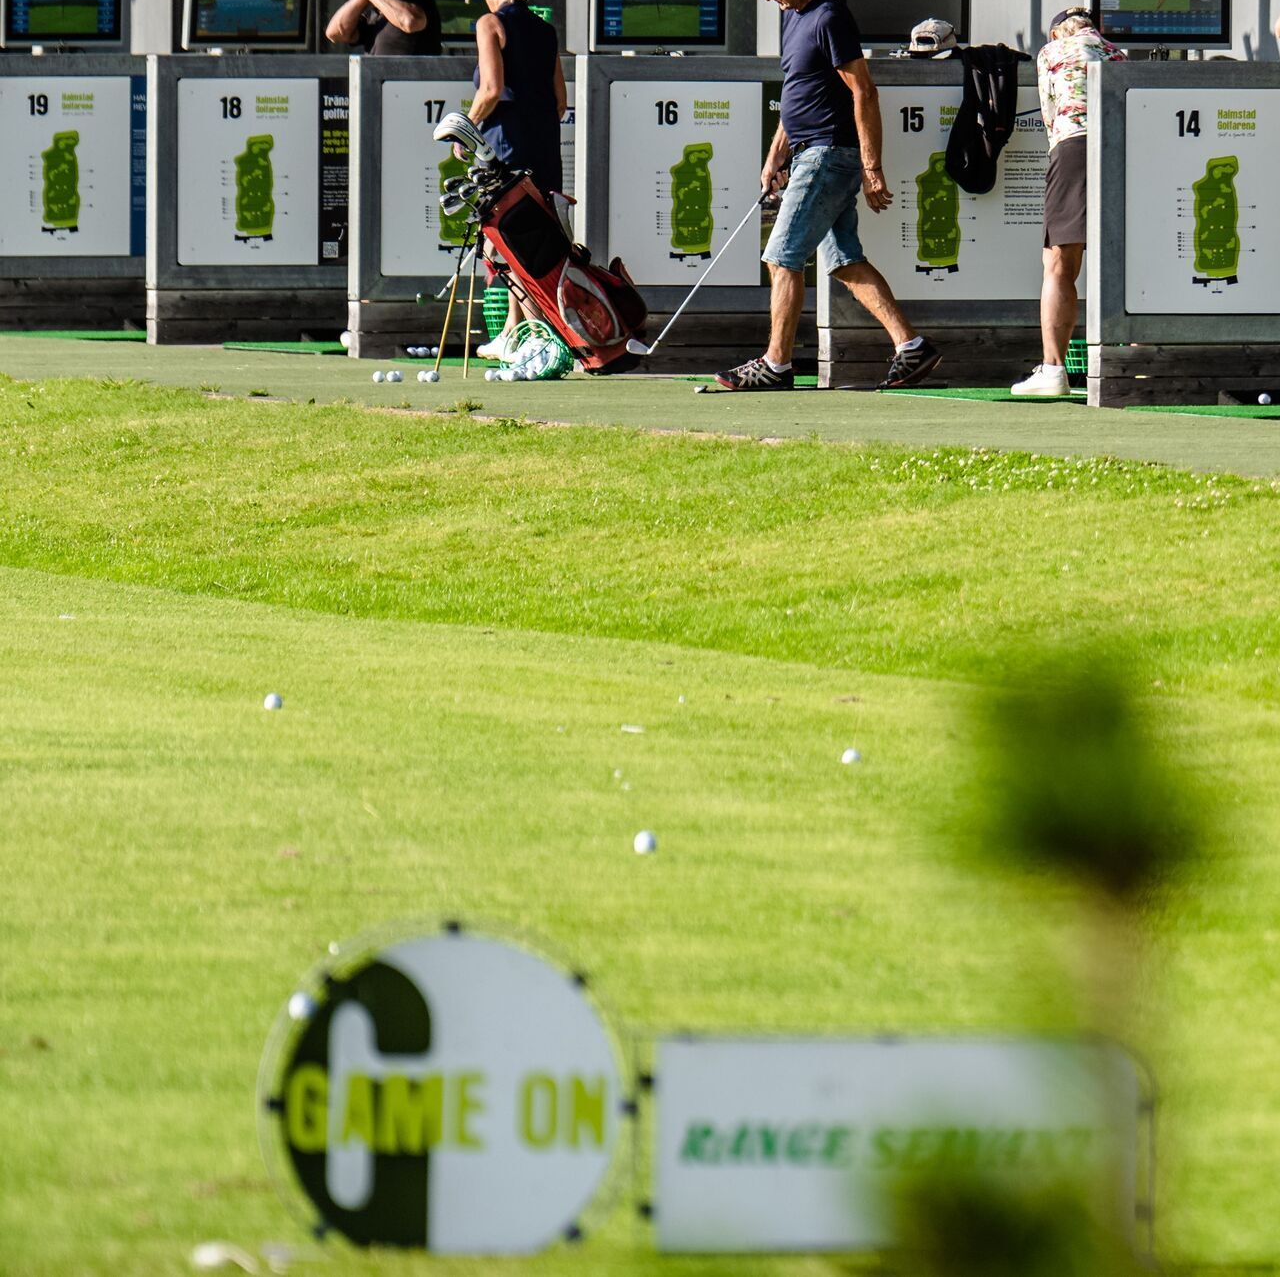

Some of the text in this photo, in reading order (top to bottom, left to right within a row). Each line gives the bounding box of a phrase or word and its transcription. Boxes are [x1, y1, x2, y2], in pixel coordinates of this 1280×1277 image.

[28, 94, 49, 115] 19
[220, 97, 242, 119] 18
[424, 100, 446, 123] 17
[655, 101, 678, 125] 16
[694, 100, 730, 109] Halmstad
[694, 111, 730, 119] Golfarena
[1217, 109, 1256, 119] Halmstad
[900, 107, 924, 132] 15
[1014, 118, 1045, 127] Halla
[1175, 110, 1200, 137] 14
[1217, 121, 1256, 130] Golfarena
[287, 1065, 607, 1155] GAME ON
[680, 1120, 850, 1166] RANGE
